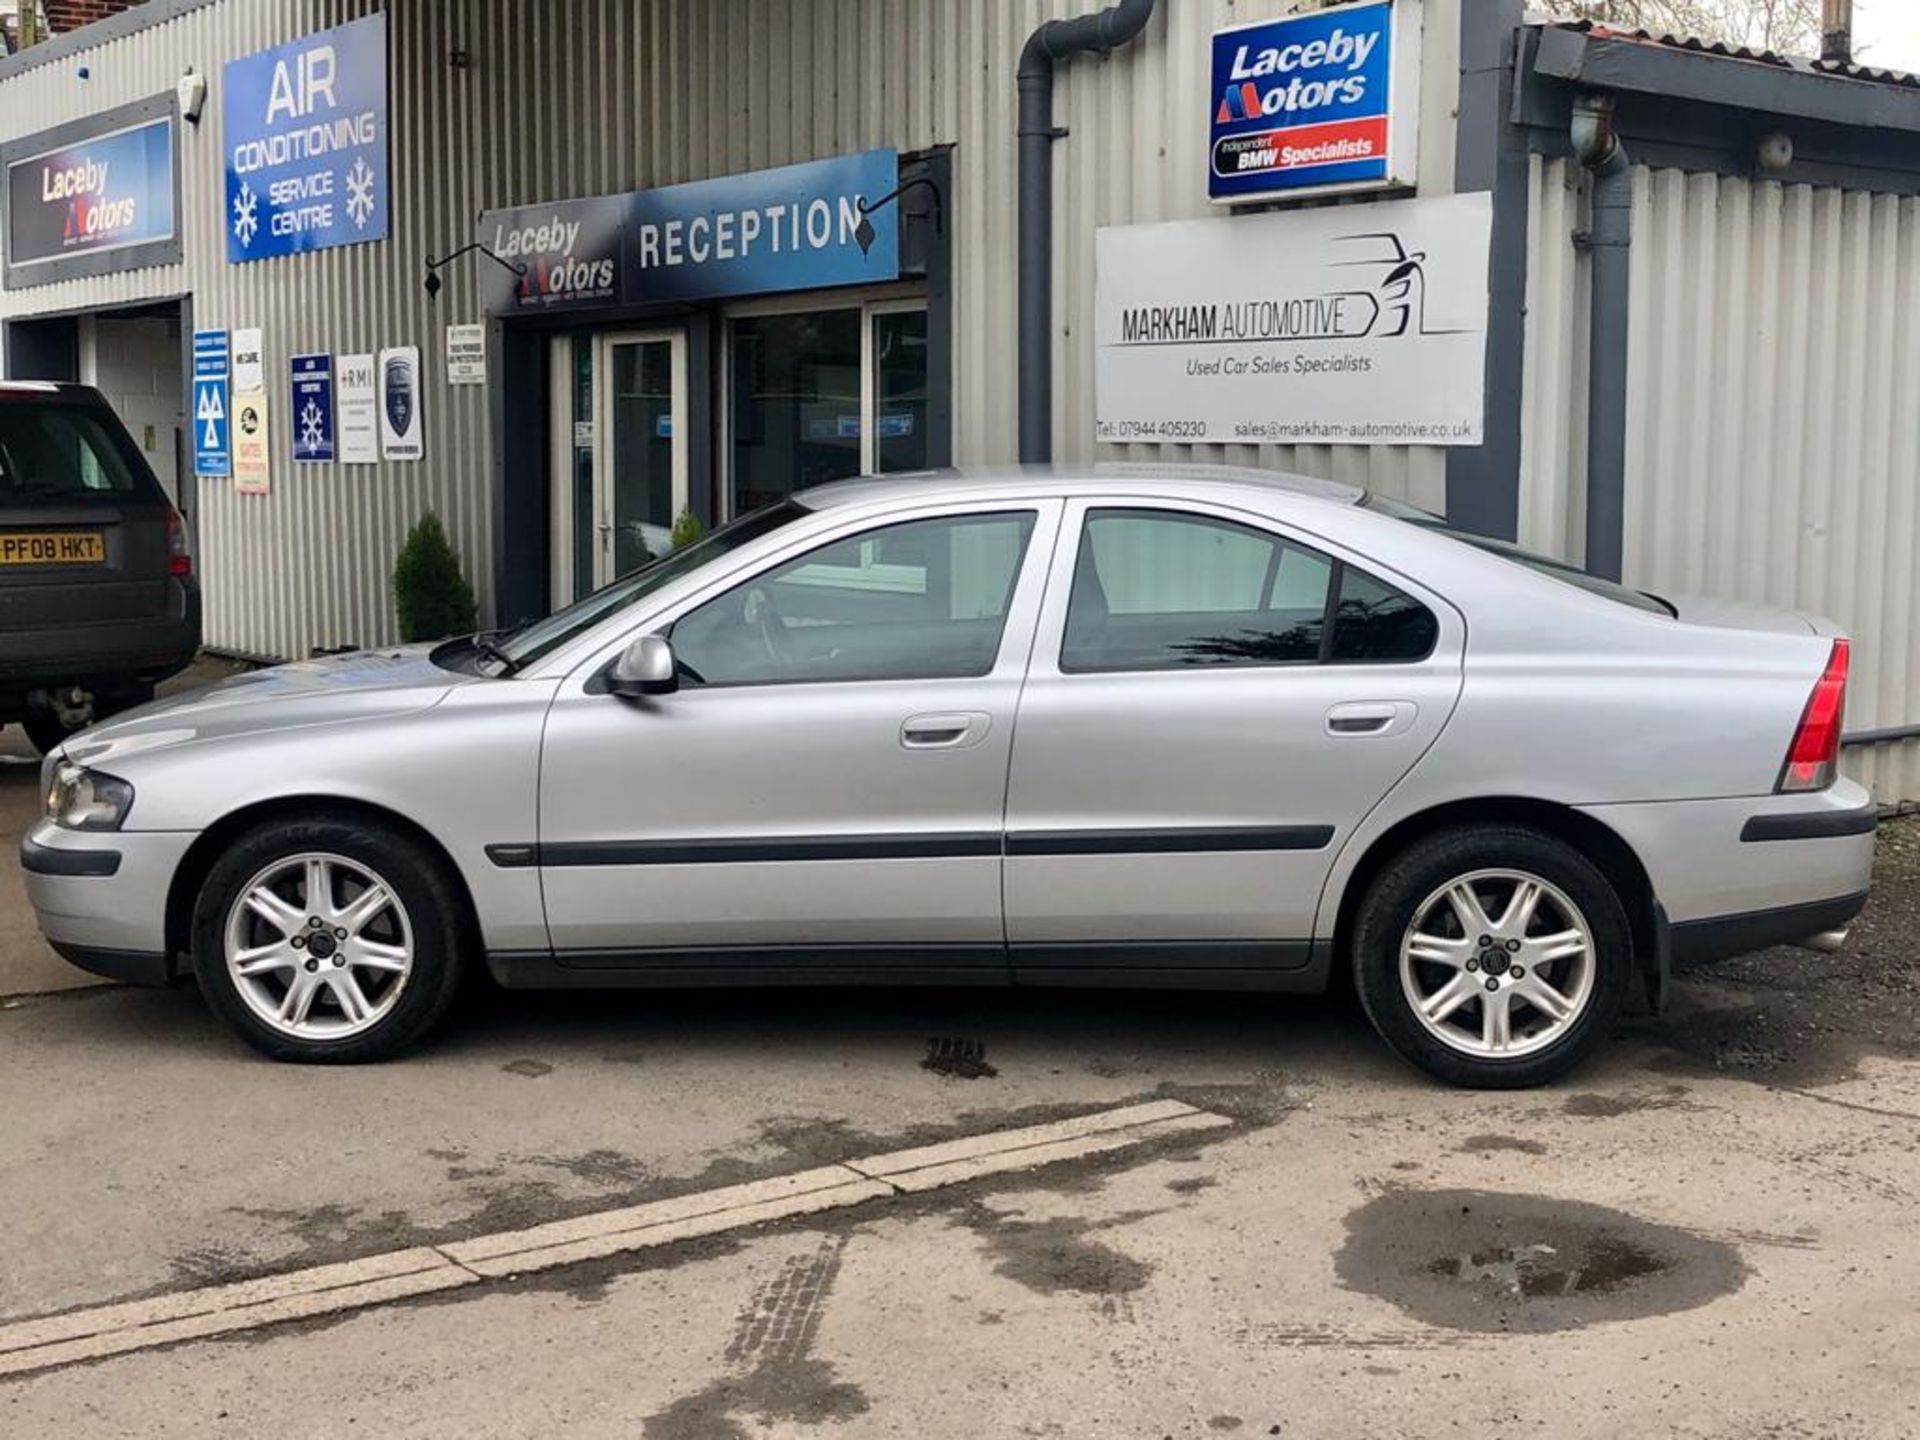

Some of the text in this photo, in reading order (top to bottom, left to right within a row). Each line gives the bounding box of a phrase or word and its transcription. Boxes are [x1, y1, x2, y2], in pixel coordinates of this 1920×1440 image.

[1230, 29, 1380, 80] Laceby
[266, 45, 336, 125] AIR
[1216, 75, 1366, 124] Motors
[234, 112, 374, 174] CONDITIONING
[1222, 136, 1273, 153] Independent
[1238, 138, 1373, 169] BMW Specialists
[43, 157, 108, 202] Laceby
[270, 171, 334, 206] SERVICE
[63, 196, 135, 237] Motors
[271, 203, 333, 236] CENTRE
[494, 214, 580, 258] Laceby
[640, 195, 861, 269] RECEPTION
[1123, 298, 1345, 341] MARKHAM AUTOMOTIVE
[1186, 354, 1371, 375] Used Car Sales Specialists
[1097, 420, 1471, 439] Tel: 07944 405230 sales@markham-automotive.co.uk
[4, 538, 96, 559] PF08 HKT
